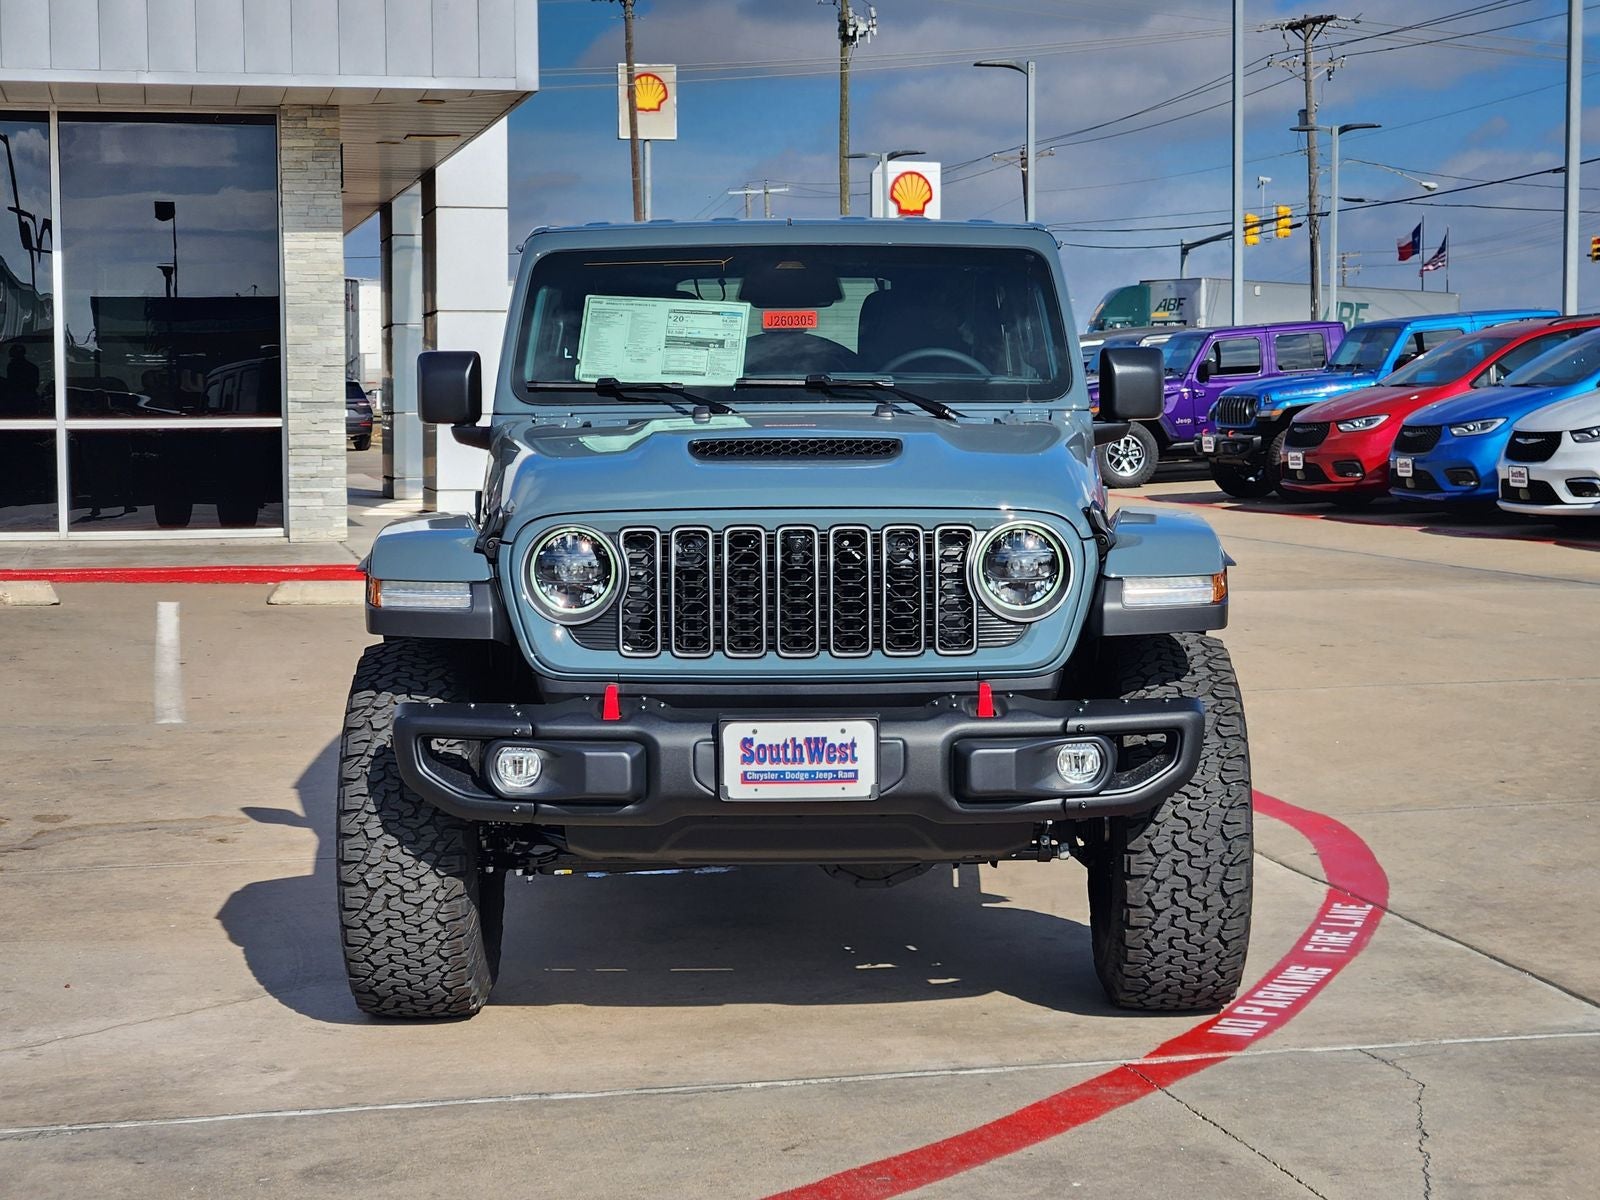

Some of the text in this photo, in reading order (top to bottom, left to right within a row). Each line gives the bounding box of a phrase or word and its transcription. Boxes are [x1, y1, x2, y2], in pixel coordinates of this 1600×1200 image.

[1155, 298, 1186, 312] ABF
[673, 315, 684, 323] 20
[767, 315, 814, 327] J260305
[740, 736, 858, 765] SouthWest
[746, 770, 855, 781] Chrysler Dodge Jeep Ram
[1207, 902, 1374, 1037] NO PARKING FIRE LANE
